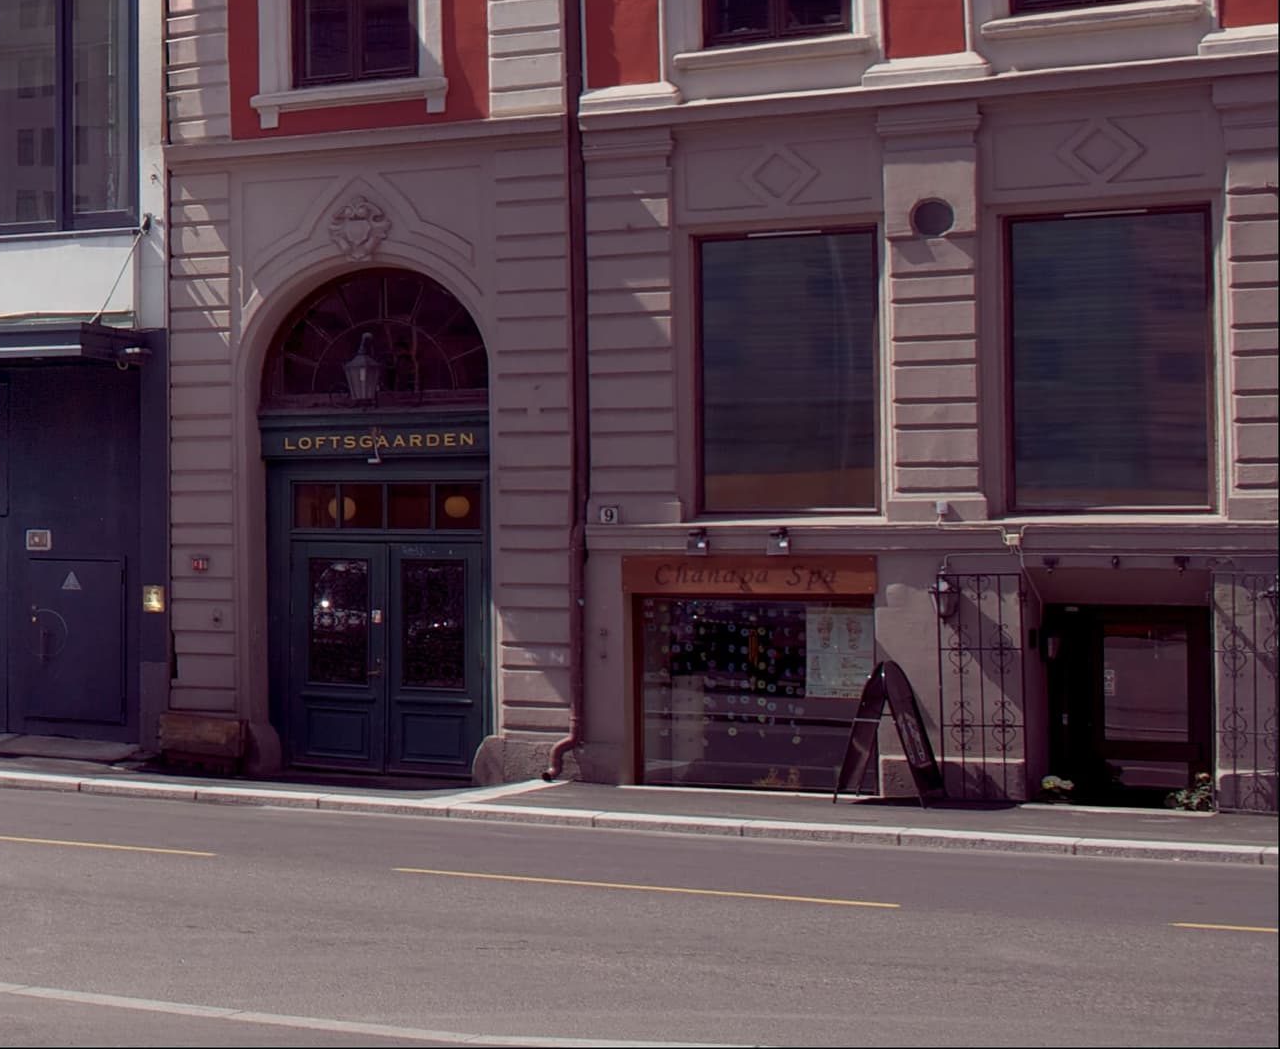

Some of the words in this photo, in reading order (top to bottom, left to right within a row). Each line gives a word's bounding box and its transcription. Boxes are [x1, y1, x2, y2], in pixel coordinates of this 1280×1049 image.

[284, 432, 474, 451] LOFTSGAARDEN
[603, 507, 614, 522] 9
[786, 565, 837, 590] Spa
